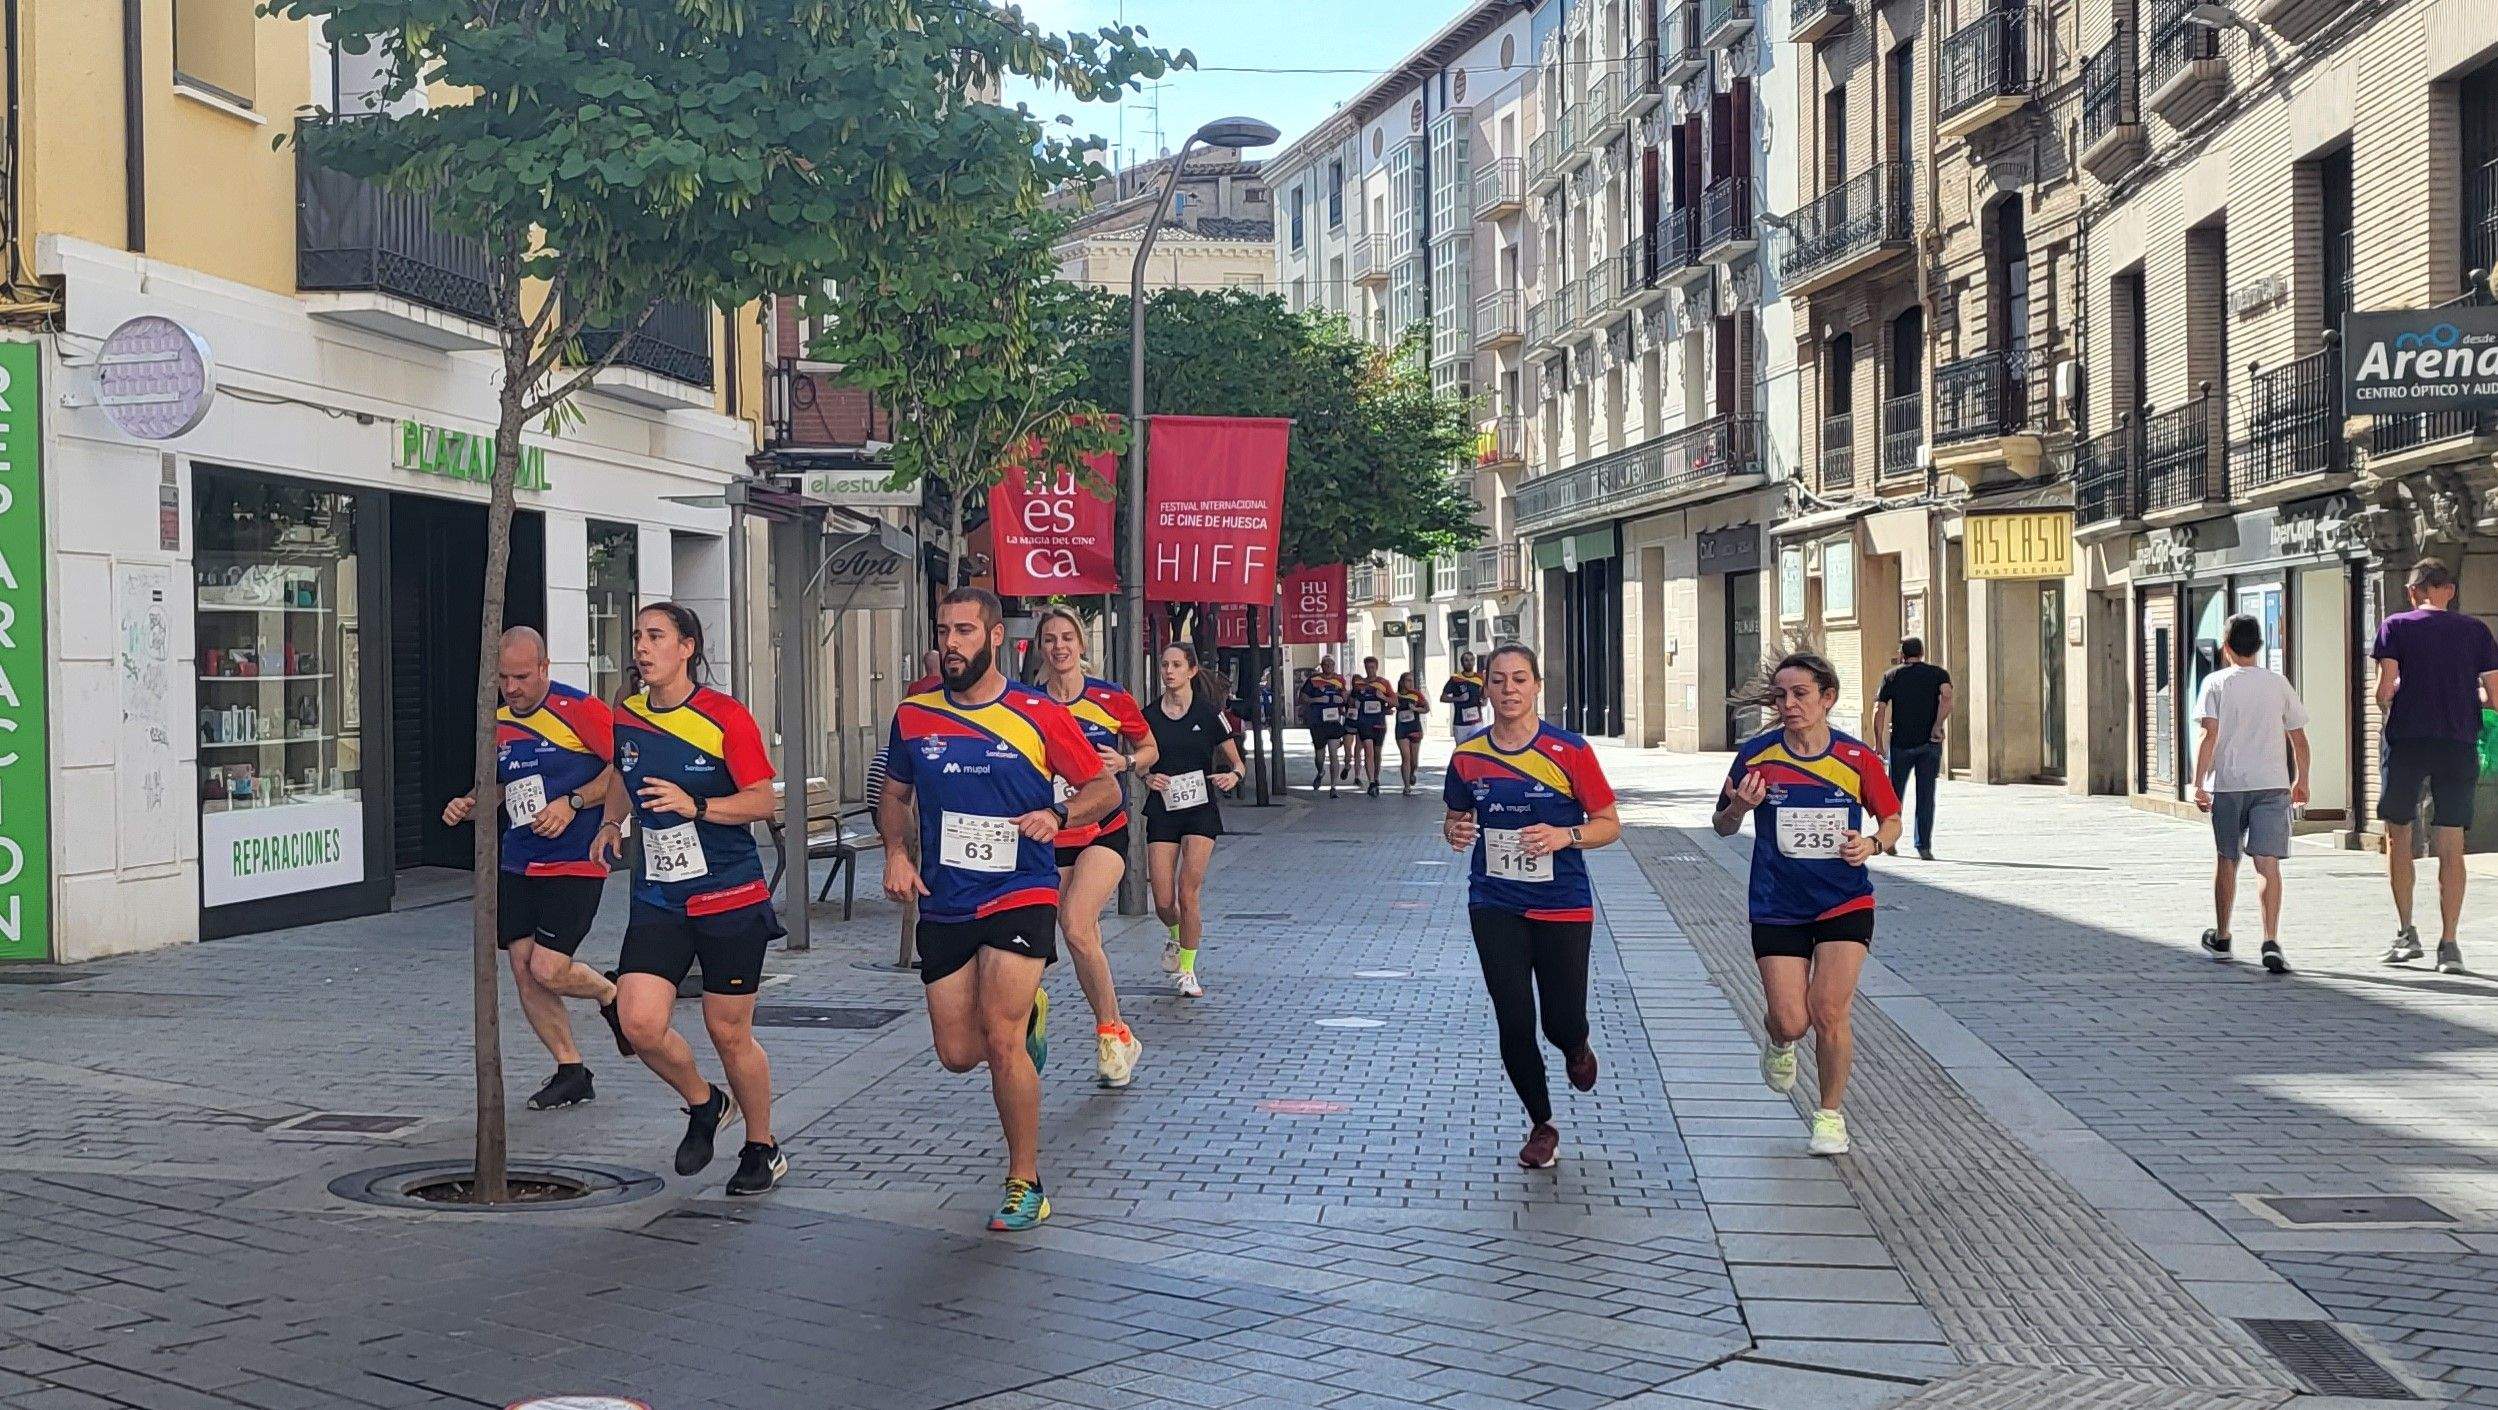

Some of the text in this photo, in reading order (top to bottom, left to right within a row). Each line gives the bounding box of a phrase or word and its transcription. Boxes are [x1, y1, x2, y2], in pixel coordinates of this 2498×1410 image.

[2355, 341, 2498, 381] Arena
[2356, 385, 2407, 400] CENTRO
[2411, 382, 2459, 398] ÓPTICO
[2461, 383, 2471, 396] Y
[402, 419, 552, 491] PLAZAVIL
[810, 475, 916, 494] el.estuo
[1023, 499, 1075, 533] es
[1160, 500, 1268, 512] FESTIVAL INTERNACIONAL
[1160, 513, 1268, 530] DE CINE DE HUESCA
[1973, 515, 2065, 565] ASCASO
[1025, 548, 1081, 579] ca
[1156, 542, 1267, 584] HIFF
[1301, 595, 1328, 612] es
[1302, 619, 1329, 636] ca
[1172, 788, 1198, 803] 567
[512, 798, 537, 819] 116
[1793, 832, 1835, 849] 235
[232, 827, 341, 878] REPARACIONES
[964, 841, 993, 862] 63
[653, 852, 690, 873] 234
[1500, 854, 1538, 873] 115
